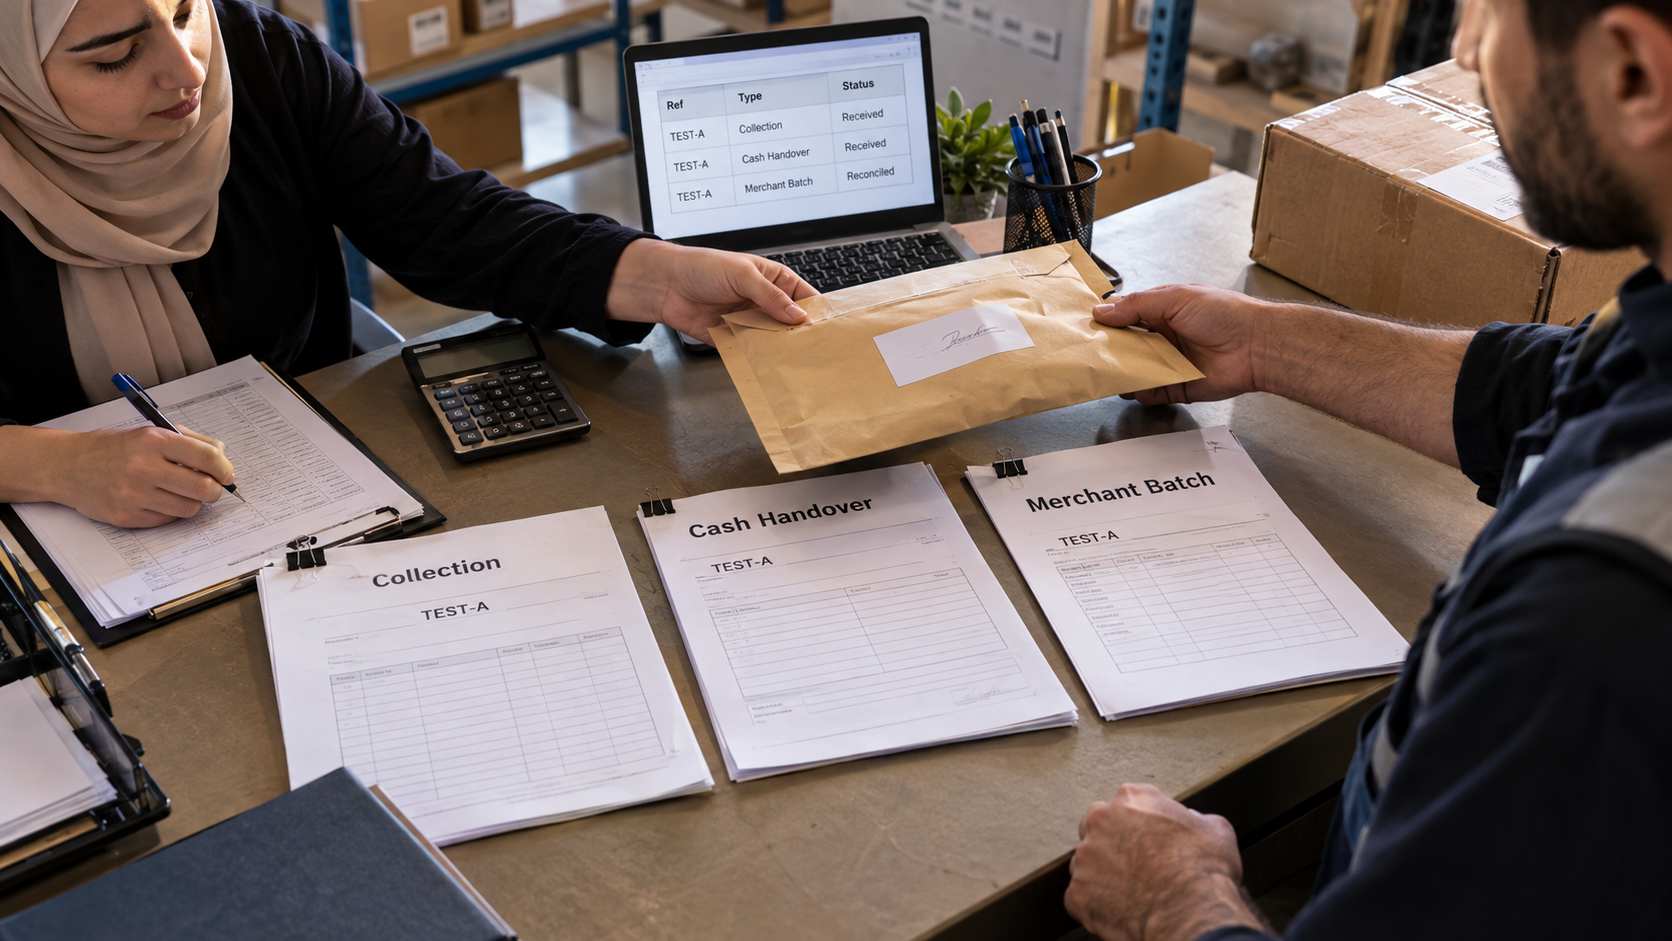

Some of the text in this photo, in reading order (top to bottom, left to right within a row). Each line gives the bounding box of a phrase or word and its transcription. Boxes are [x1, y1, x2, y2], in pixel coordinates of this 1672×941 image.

[666, 78, 875, 111] Ref Type Status
[669, 108, 884, 142] TEST-A Collection Received
[673, 138, 887, 173] TEST-A Cash Handover Received
[676, 166, 895, 202] TEST-A Merchant Batch Reconciled
[1025, 470, 1217, 513] Merchant Batch
[688, 497, 874, 539] Cash Handover
[1058, 529, 1120, 548] TEST-A
[371, 555, 502, 588] Collection
[710, 555, 774, 574] TEST-A
[420, 600, 490, 621] TEST-A
